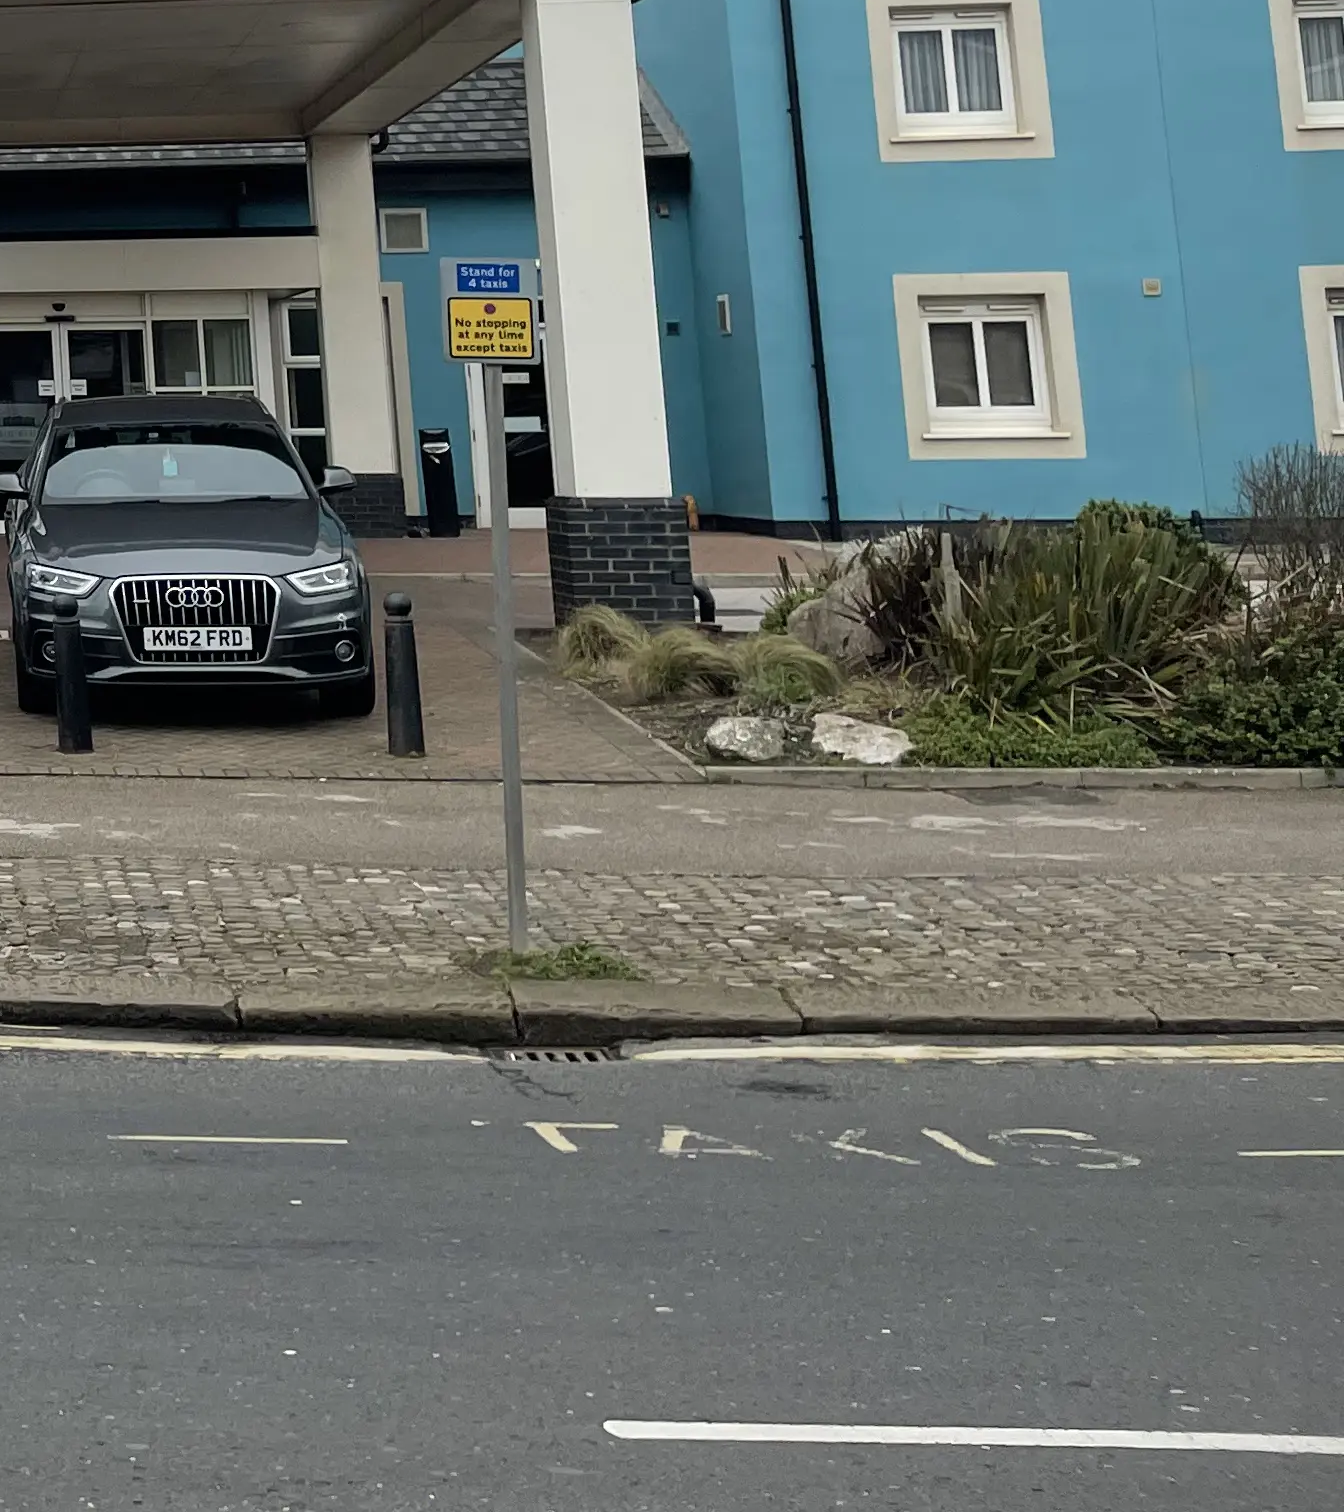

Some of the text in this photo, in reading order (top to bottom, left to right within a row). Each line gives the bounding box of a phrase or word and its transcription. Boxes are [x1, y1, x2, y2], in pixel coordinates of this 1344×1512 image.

[460, 266, 515, 277] Stand for
[468, 278, 509, 288] 4 taxis
[455, 318, 527, 330] No stopping
[458, 329, 524, 341] at any time
[456, 343, 528, 354] except taxis
[152, 630, 243, 647] KM62 FRD
